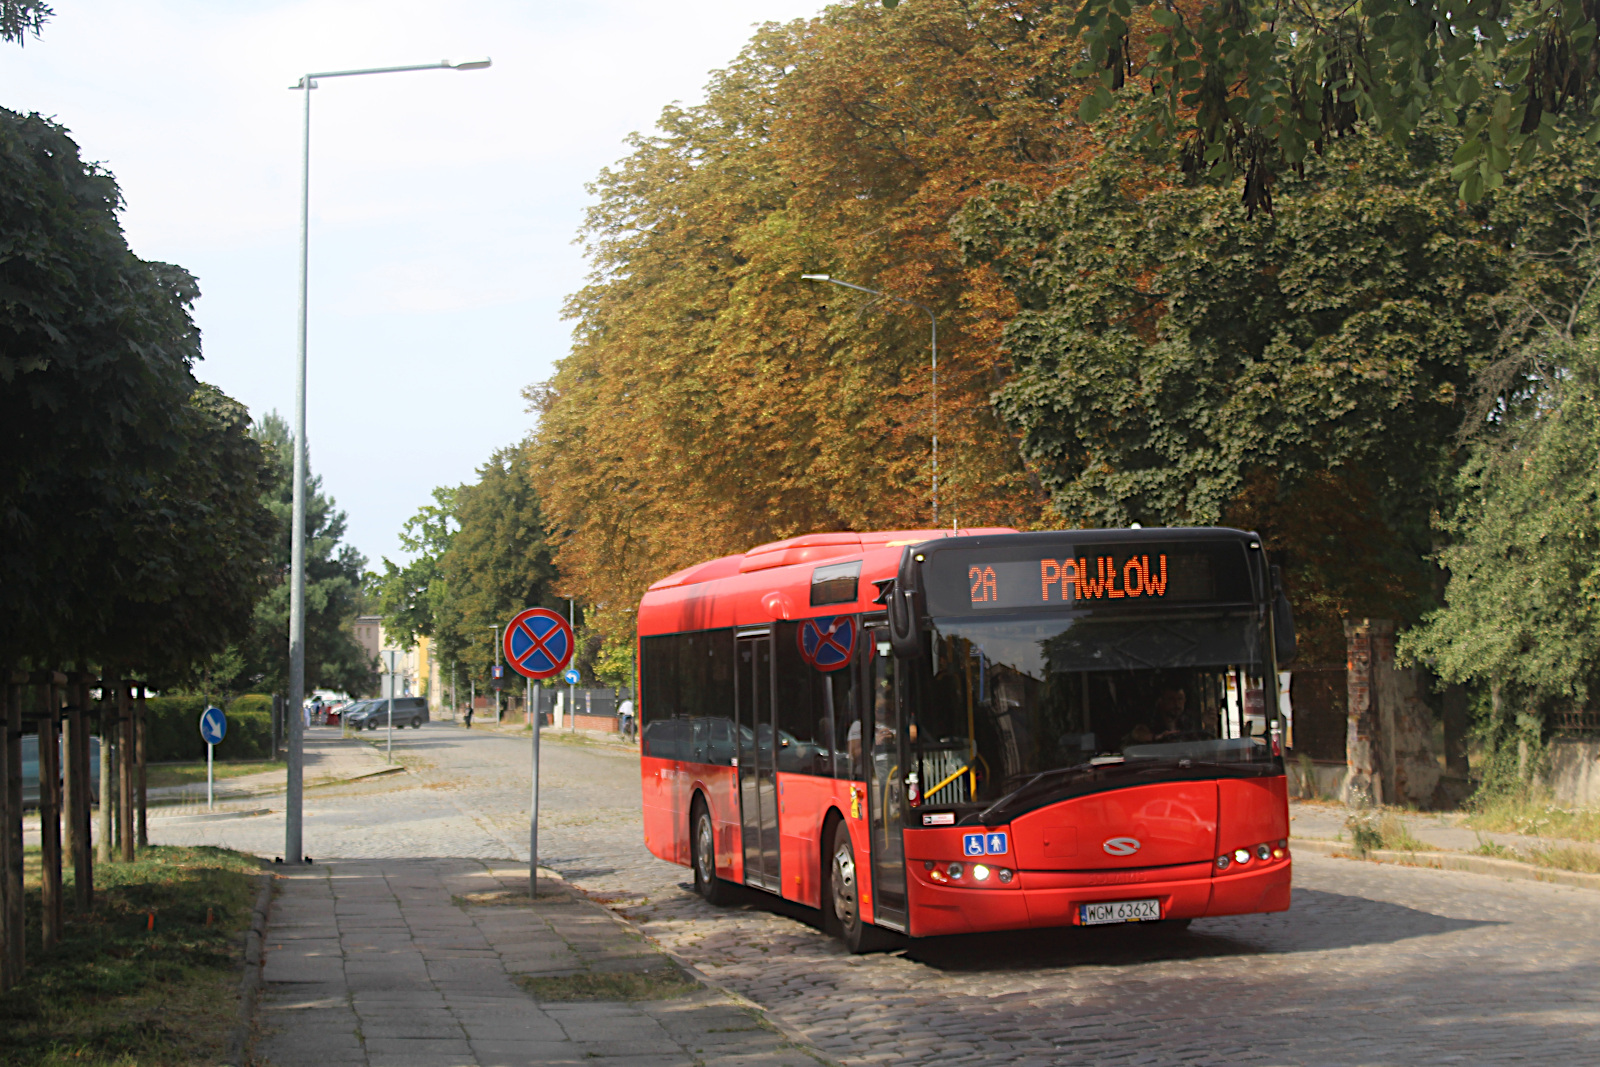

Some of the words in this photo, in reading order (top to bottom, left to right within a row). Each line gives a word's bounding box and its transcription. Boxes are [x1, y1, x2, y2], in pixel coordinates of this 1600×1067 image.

[968, 565, 997, 602] 2A
[1041, 554, 1167, 601] PAWŁÓW
[1088, 905, 1114, 920] WGM
[1117, 902, 1158, 918] 6362K
